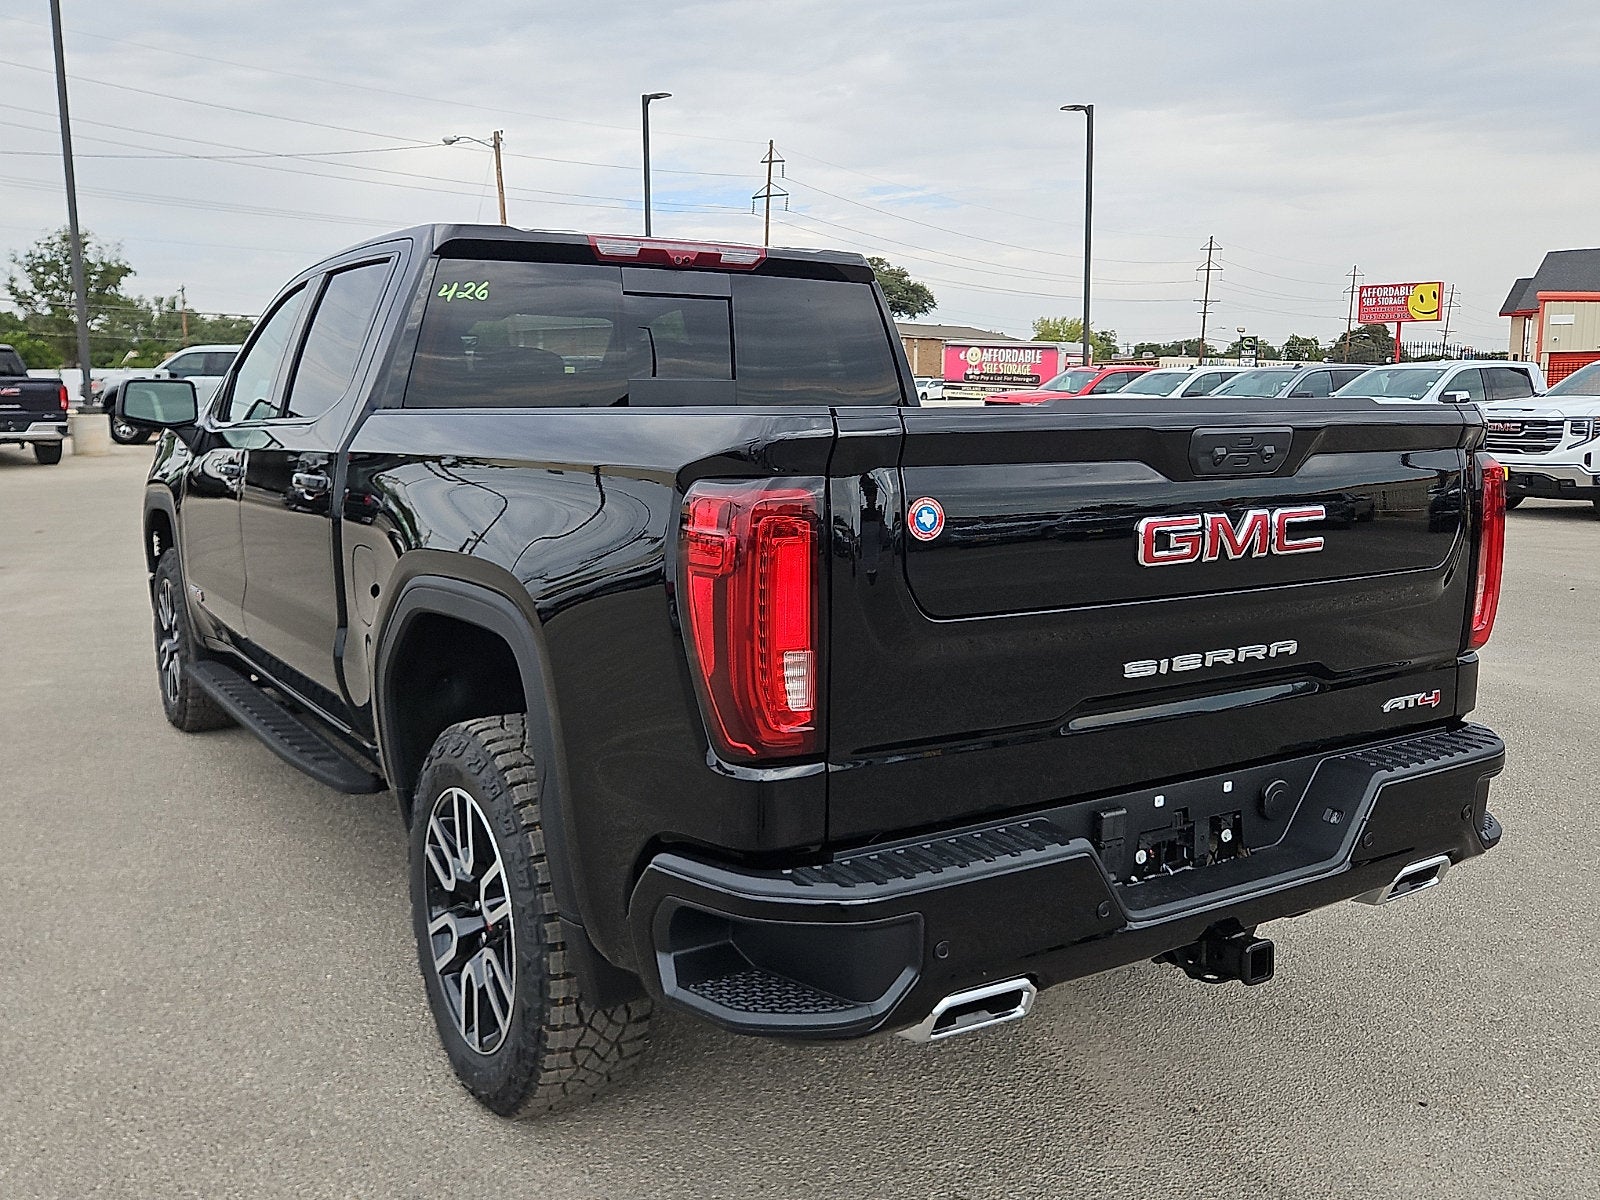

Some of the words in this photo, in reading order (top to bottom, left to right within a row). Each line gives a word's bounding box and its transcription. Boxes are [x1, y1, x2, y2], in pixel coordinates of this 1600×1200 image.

[437, 281, 489, 302] 426
[1362, 286, 1414, 297] AFFORDABLE
[1362, 298, 1377, 306] SELF
[1378, 297, 1405, 305] STORAGE
[981, 348, 1042, 363] AFFORDABLE
[982, 363, 998, 374] SELF
[999, 363, 1032, 375] STORAGE
[1488, 422, 1521, 432] GMC
[1135, 505, 1325, 567] GMC
[1123, 640, 1298, 679] SIERRA
[1382, 689, 1440, 713] AT4
